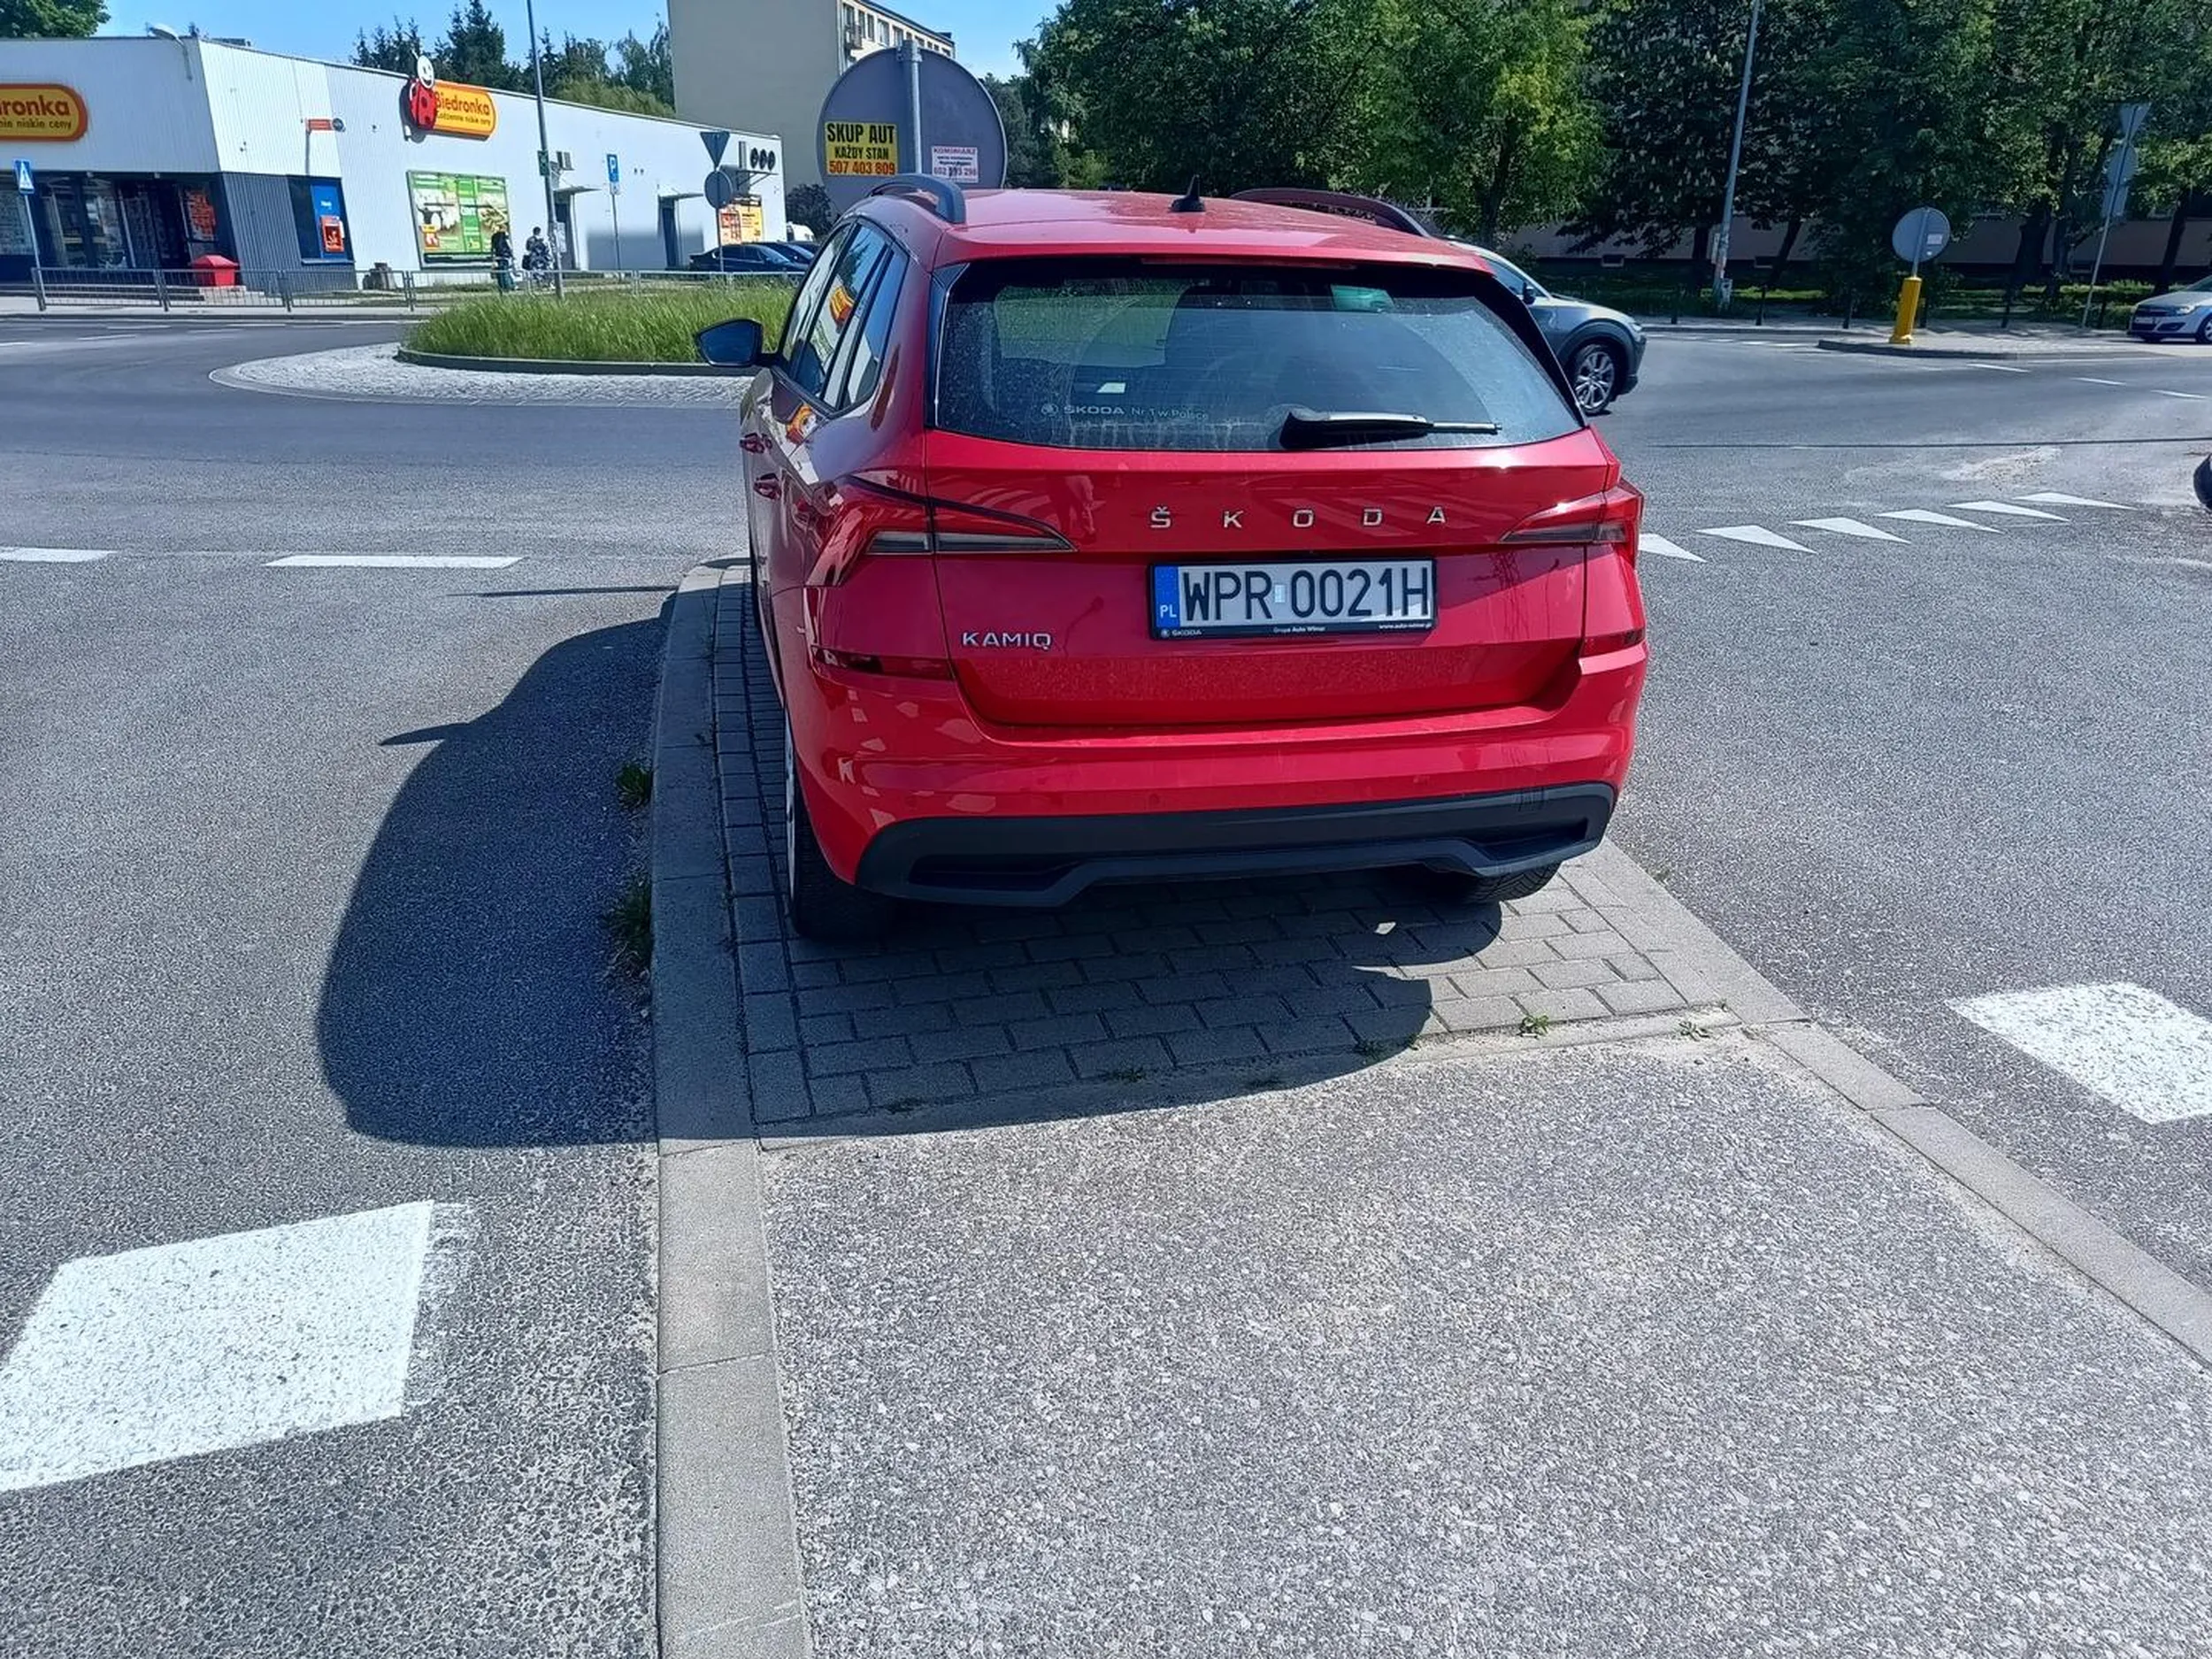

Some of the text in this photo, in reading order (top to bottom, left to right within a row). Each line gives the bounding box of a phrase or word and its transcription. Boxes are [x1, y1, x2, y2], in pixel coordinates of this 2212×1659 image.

[0, 95, 70, 115] ronka
[434, 91, 489, 116] Biedronka
[49, 120, 71, 130] ceny
[827, 123, 895, 143] SKUP AUT
[834, 144, 888, 159] KAŻDY STAN
[829, 160, 849, 173] 507
[852, 161, 872, 174] 403
[1131, 406, 1147, 416] Nr
[1150, 505, 1447, 529] ŠKODA
[1182, 567, 1429, 621] WPR 0021H
[1160, 604, 1178, 618] PL
[962, 632, 1052, 650] KAMIQ
